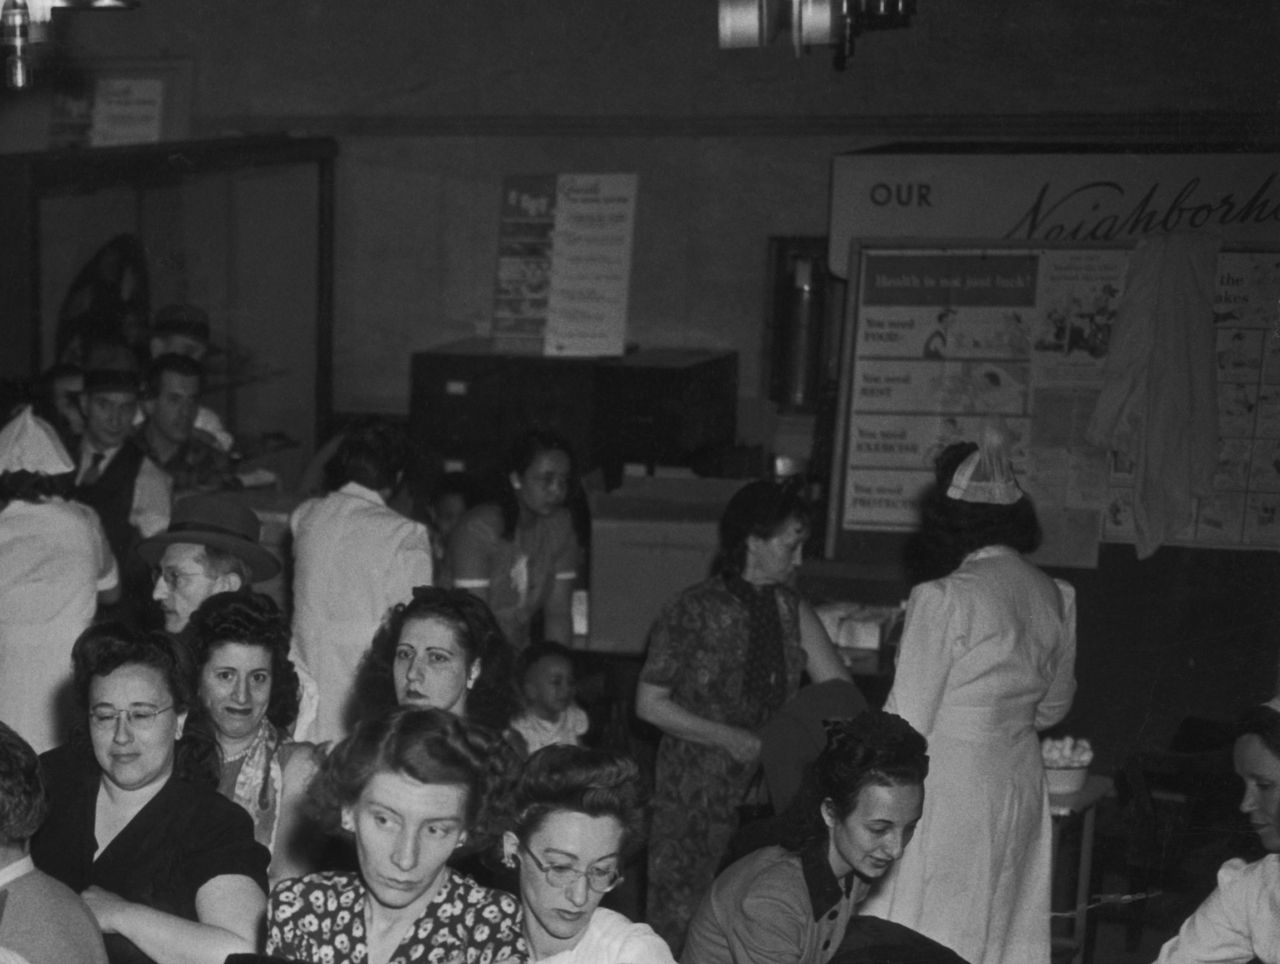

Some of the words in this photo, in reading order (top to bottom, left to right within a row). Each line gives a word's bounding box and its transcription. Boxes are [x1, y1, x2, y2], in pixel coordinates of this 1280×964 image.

[870, 182, 932, 207] OUR
[874, 273, 920, 288] Health
[923, 275, 936, 287] is
[939, 275, 961, 288] not
[964, 273, 992, 289] just
[1220, 272, 1244, 286] the
[1214, 290, 1250, 304] akes
[865, 318, 885, 329] You
[887, 318, 915, 330] need
[862, 374, 881, 383] You
[884, 374, 911, 384] need
[858, 429, 876, 439] You
[880, 430, 907, 439] need
[875, 485, 903, 495] need
